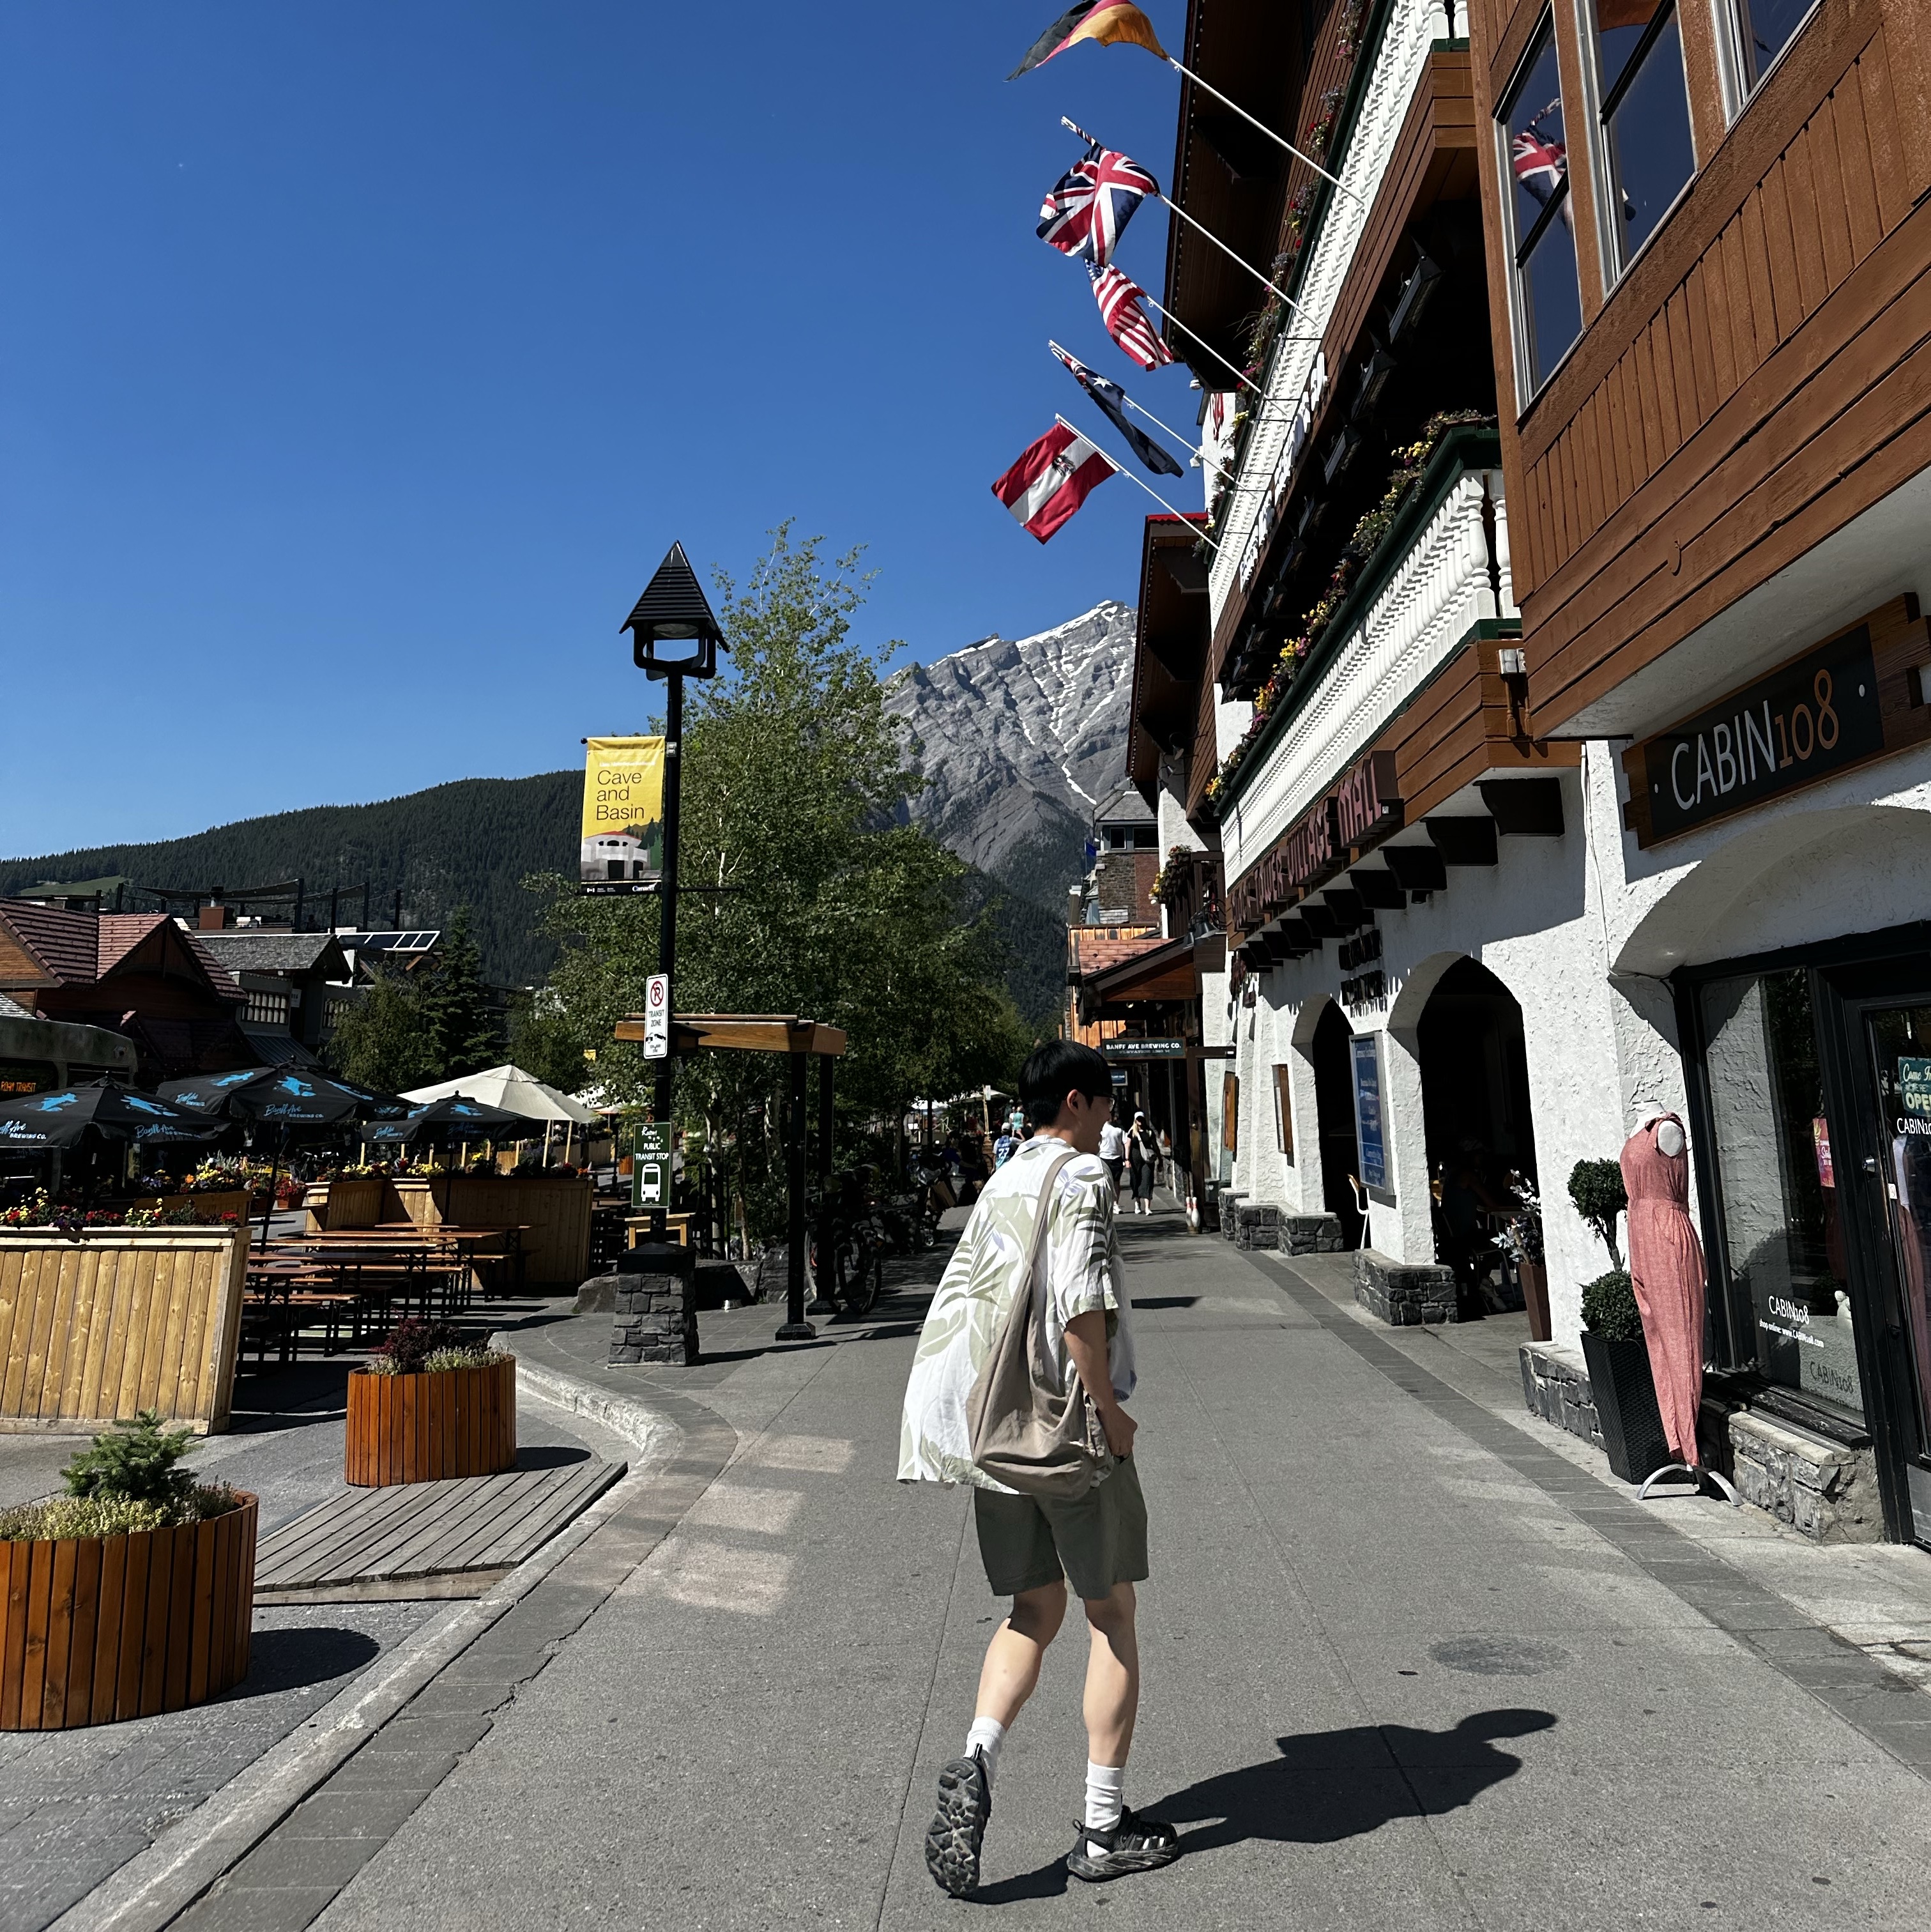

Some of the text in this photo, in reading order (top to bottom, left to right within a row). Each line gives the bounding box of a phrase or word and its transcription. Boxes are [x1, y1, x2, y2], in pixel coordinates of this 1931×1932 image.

[1672, 669, 1839, 810] CABIN108
[597, 770, 642, 785] Cave
[597, 785, 629, 802] and
[1338, 754, 1385, 848] MALL
[597, 804, 644, 820] Basin
[648, 1009, 664, 1018] TRANSIT
[651, 1019, 661, 1027] ZONE
[1903, 1063, 1922, 1082] Come
[264, 1103, 289, 1116] Banff
[1905, 1092, 1931, 1110] OPE
[1769, 1296, 1810, 1325] CABIN108
